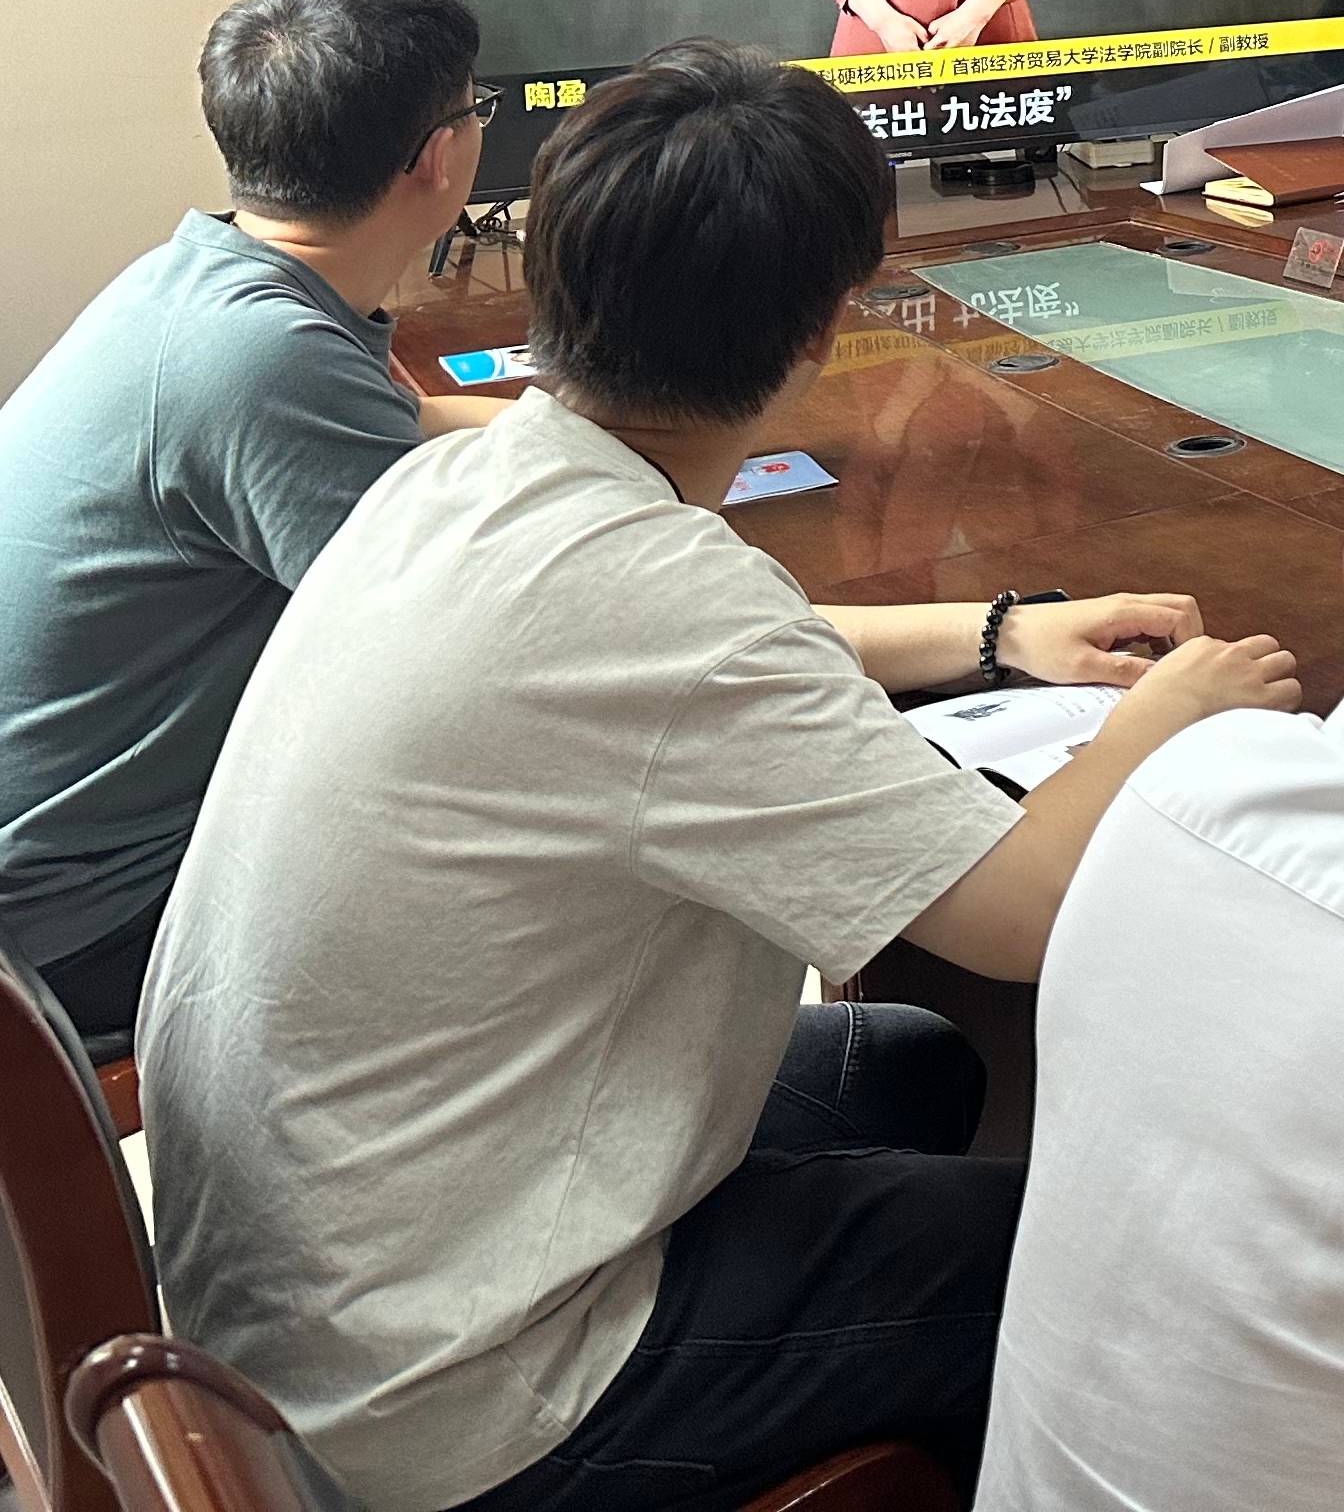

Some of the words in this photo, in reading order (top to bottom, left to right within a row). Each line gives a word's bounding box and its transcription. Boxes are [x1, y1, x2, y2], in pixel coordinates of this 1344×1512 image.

[952, 38, 1204, 76] 首都经济贸易大学法学院副院长
[1219, 32, 1270, 54] 副教授
[940, 86, 1072, 134] 九法废”
